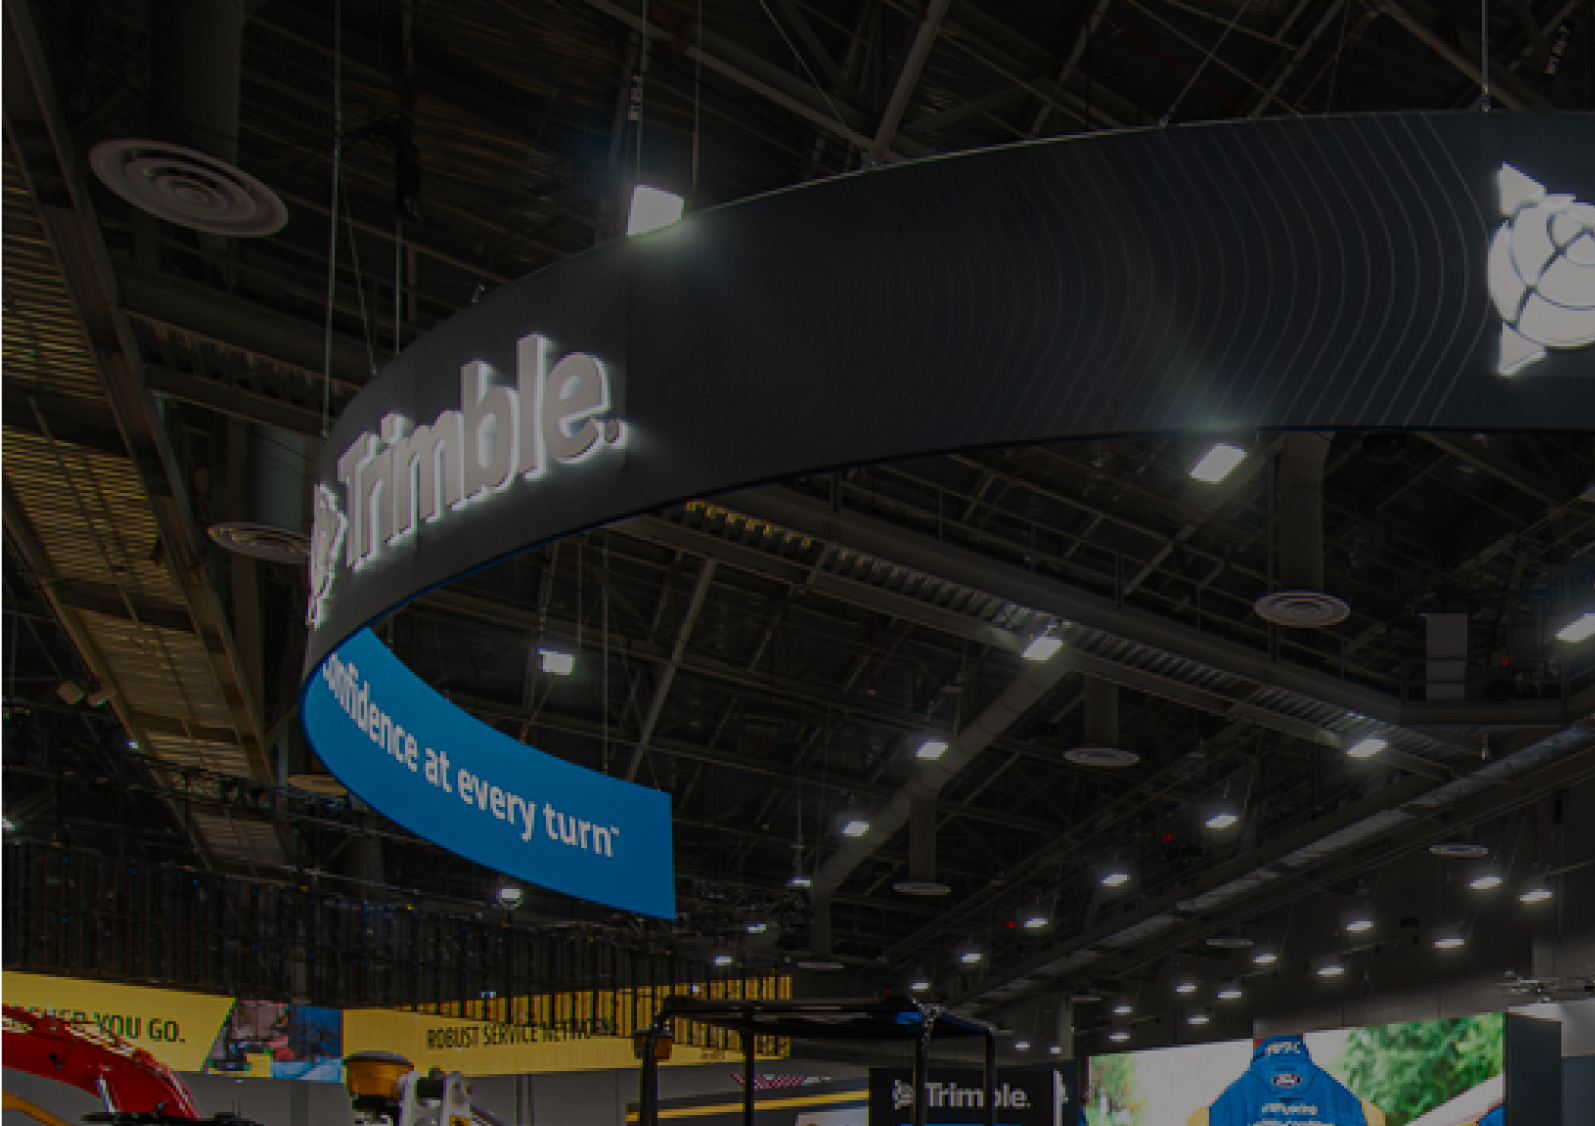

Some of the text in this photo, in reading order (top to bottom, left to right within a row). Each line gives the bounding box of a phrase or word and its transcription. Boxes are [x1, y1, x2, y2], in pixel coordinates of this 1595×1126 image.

[323, 651, 420, 772] onfidence
[423, 747, 452, 793] at
[457, 768, 537, 843] every
[147, 1017, 186, 1043] GO.
